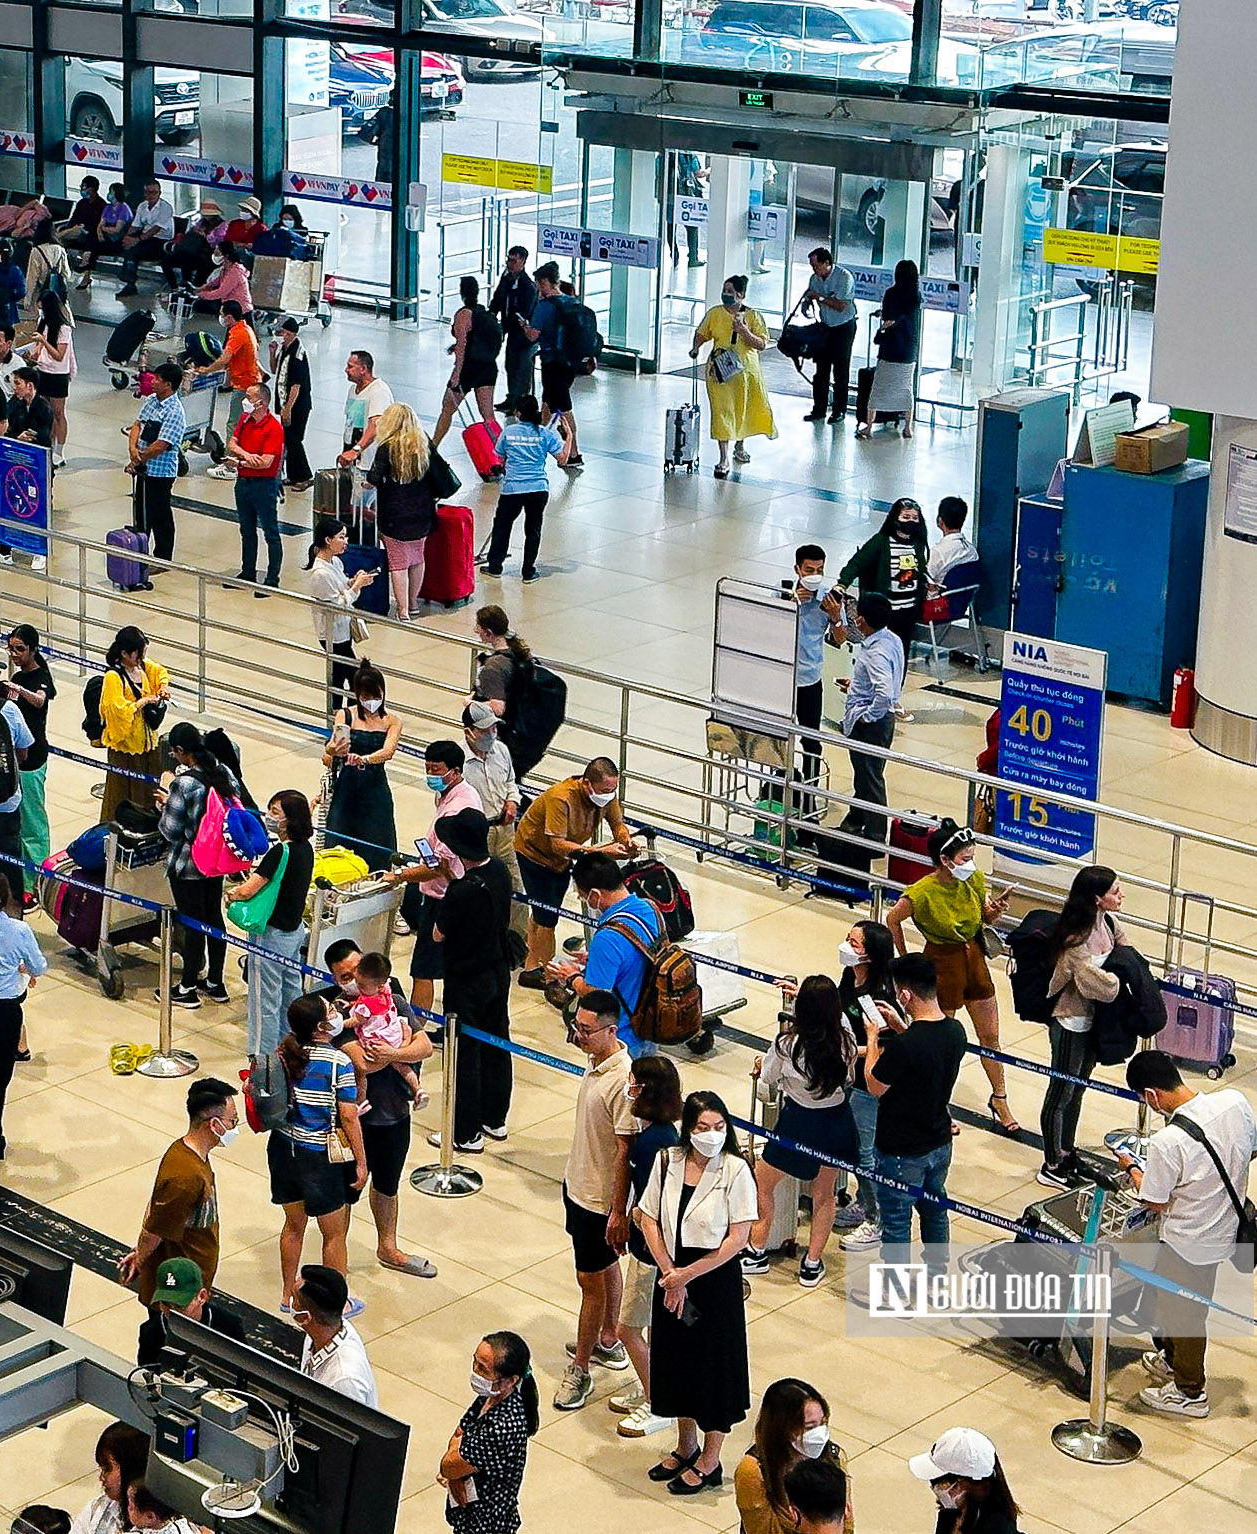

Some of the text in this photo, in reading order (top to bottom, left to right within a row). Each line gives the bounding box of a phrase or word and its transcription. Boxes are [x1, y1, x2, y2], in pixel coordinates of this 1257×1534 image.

[682, 200, 696, 214] Gọi
[543, 228, 579, 243] Gọi TAXI
[599, 235, 636, 251] Gọi TAXI
[855, 271, 877, 284] TAXI
[923, 281, 945, 294] TAXI
[1012, 640, 1048, 663] NIA
[1007, 677, 1084, 705] Quầy thủ tục đóng
[1007, 705, 1052, 742] 40
[1062, 715, 1085, 729] Phút
[1004, 738, 1089, 767] Trước giờ khởi hành
[1002, 765, 1020, 777] Cửa
[1021, 771, 1029, 779] ra
[1049, 777, 1065, 788] bay
[1066, 782, 1087, 796] đóng
[1007, 792, 1049, 828] 15
[999, 822, 1023, 836] Trước
[1024, 830, 1039, 840] giờ
[1040, 833, 1058, 846] khởi
[1059, 838, 1081, 851] hành
[955, 1203, 980, 1218] NOIBAI
[980, 1210, 1033, 1236] INTERNATIONAL
[1033, 1231, 1064, 1246] AIRPORT
